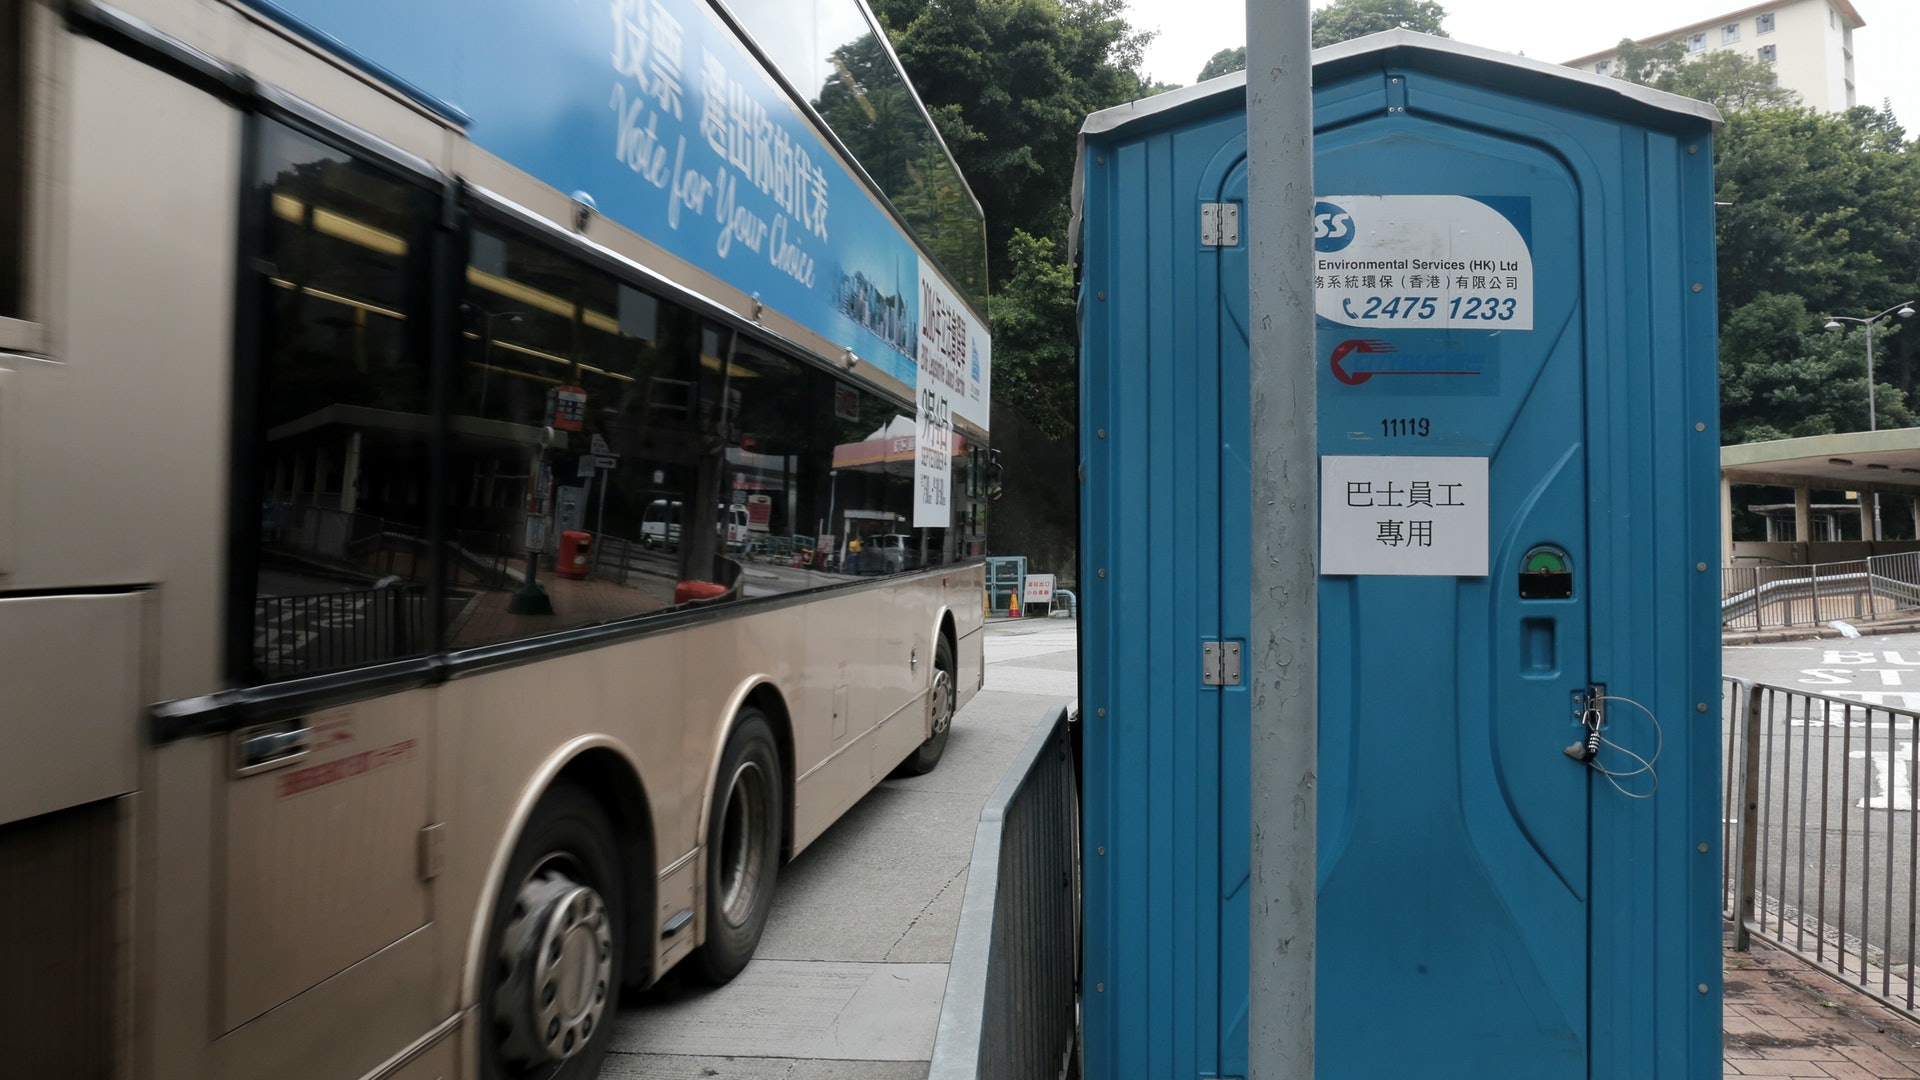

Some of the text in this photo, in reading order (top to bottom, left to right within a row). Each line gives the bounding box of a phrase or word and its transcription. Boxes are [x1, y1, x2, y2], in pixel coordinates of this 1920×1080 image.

[609, 82, 815, 289] Vote for Your Choice
[1318, 259, 1518, 273] Environmental Services (HK) Ltd
[1362, 296, 1516, 321] 2475 1233
[921, 446, 943, 471] SEPTEMBER
[1346, 481, 1465, 508] 巴士員工
[1376, 519, 1433, 548] 專用
